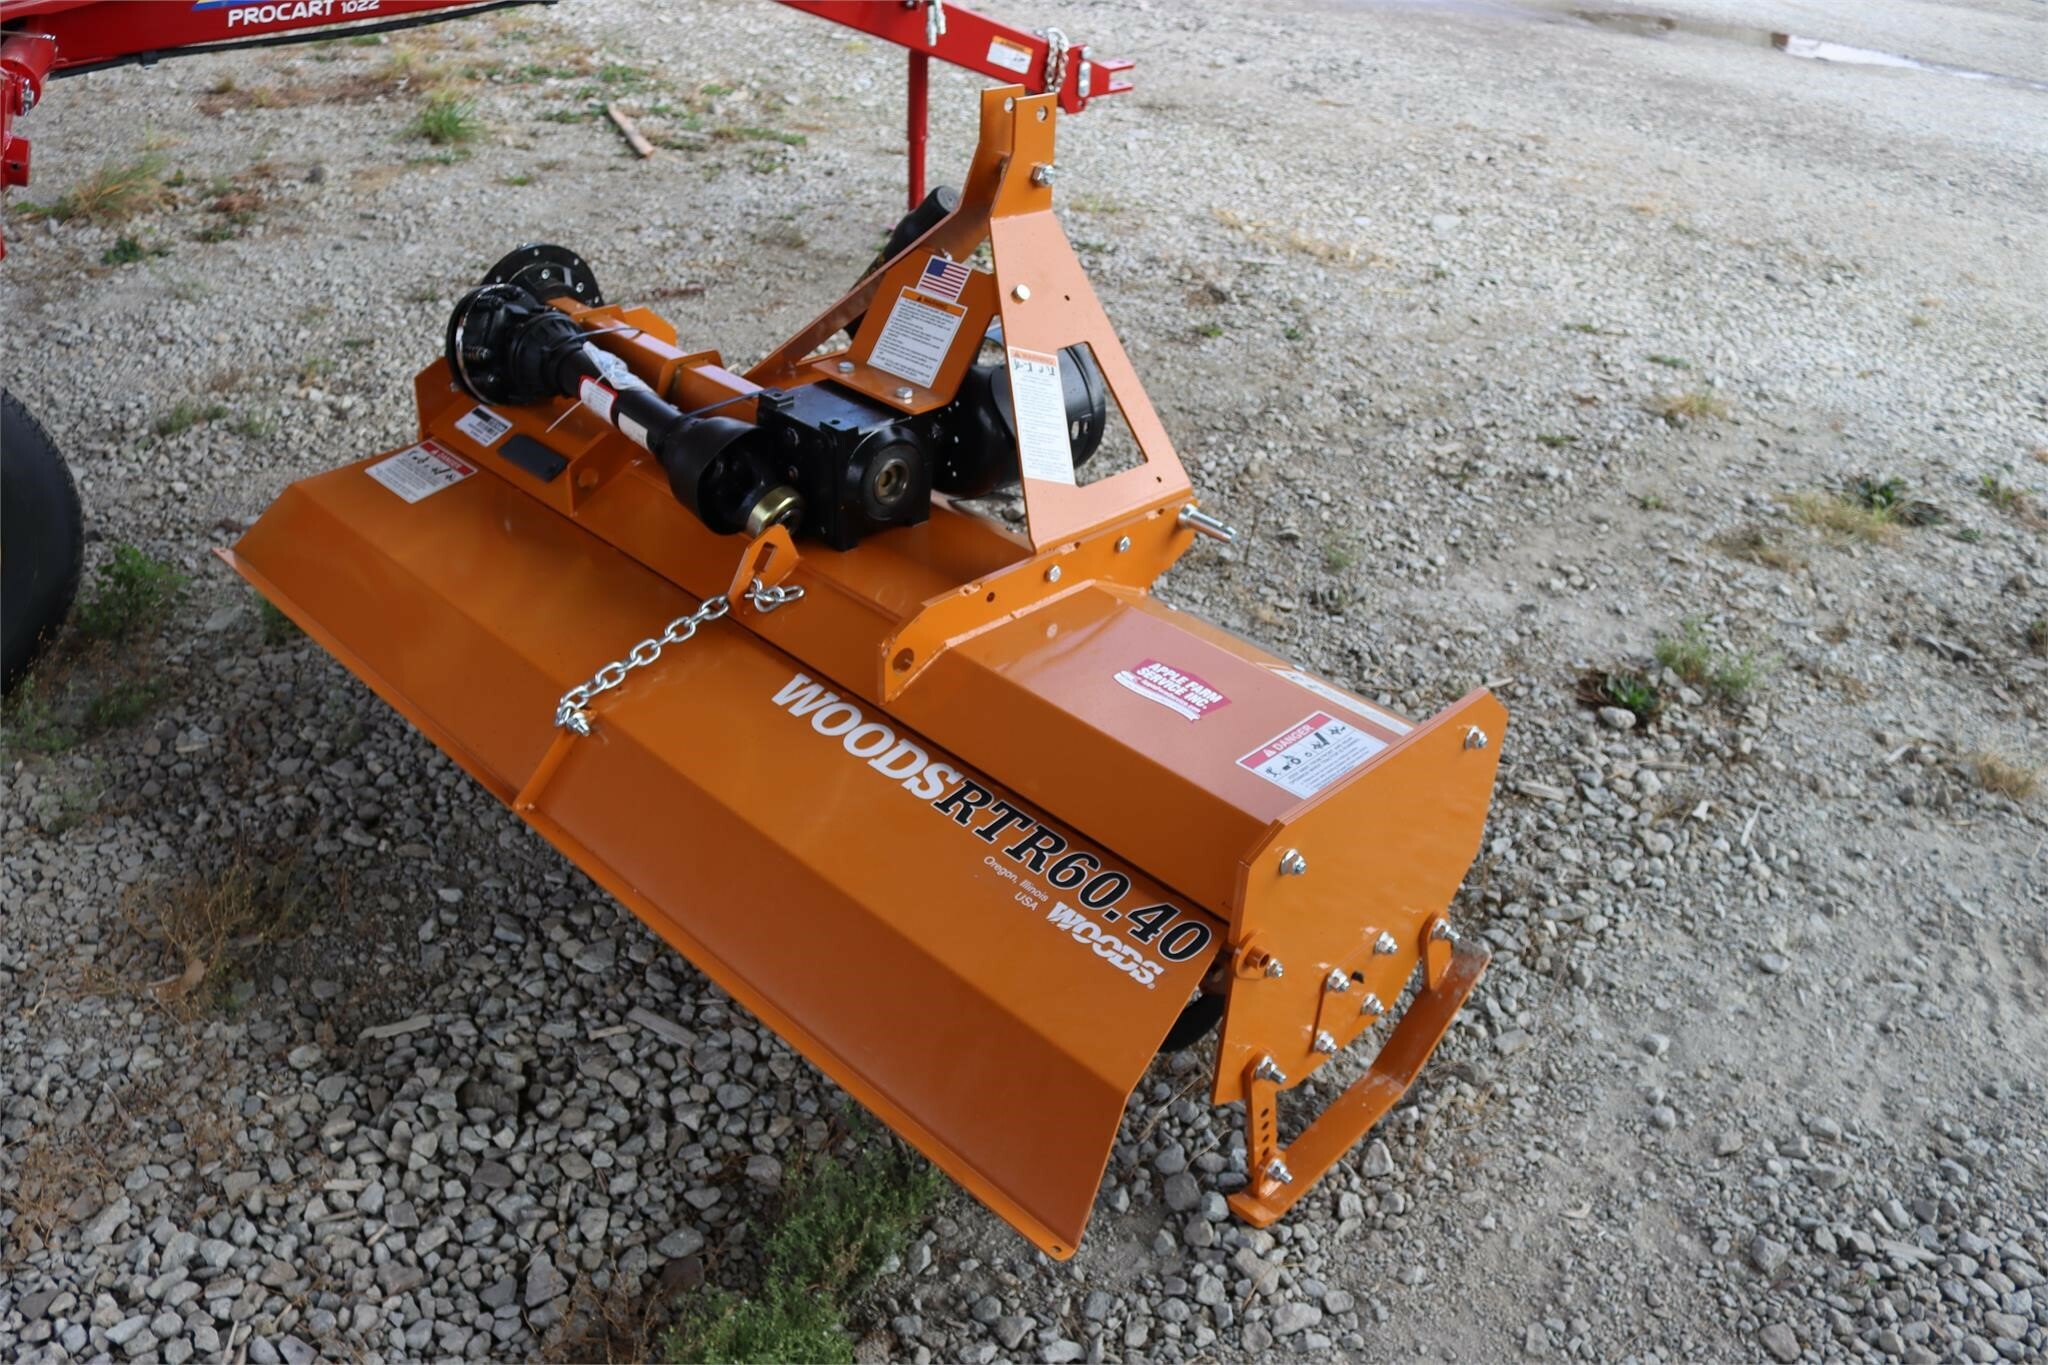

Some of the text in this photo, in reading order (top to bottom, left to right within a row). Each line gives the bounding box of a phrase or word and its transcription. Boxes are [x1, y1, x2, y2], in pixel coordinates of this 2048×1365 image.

[228, 0, 380, 27] PROCART 1022
[1136, 667, 1186, 696] SERVICE
[1147, 662, 1189, 685] APPLE
[1186, 681, 1223, 703] FARM
[1273, 724, 1315, 751] DANGER
[771, 672, 1212, 962] WOODS RTR60.40
[983, 856, 1049, 902] Oregon, Illinois
[1014, 891, 1039, 911] USA
[1046, 901, 1165, 986] WOODS
